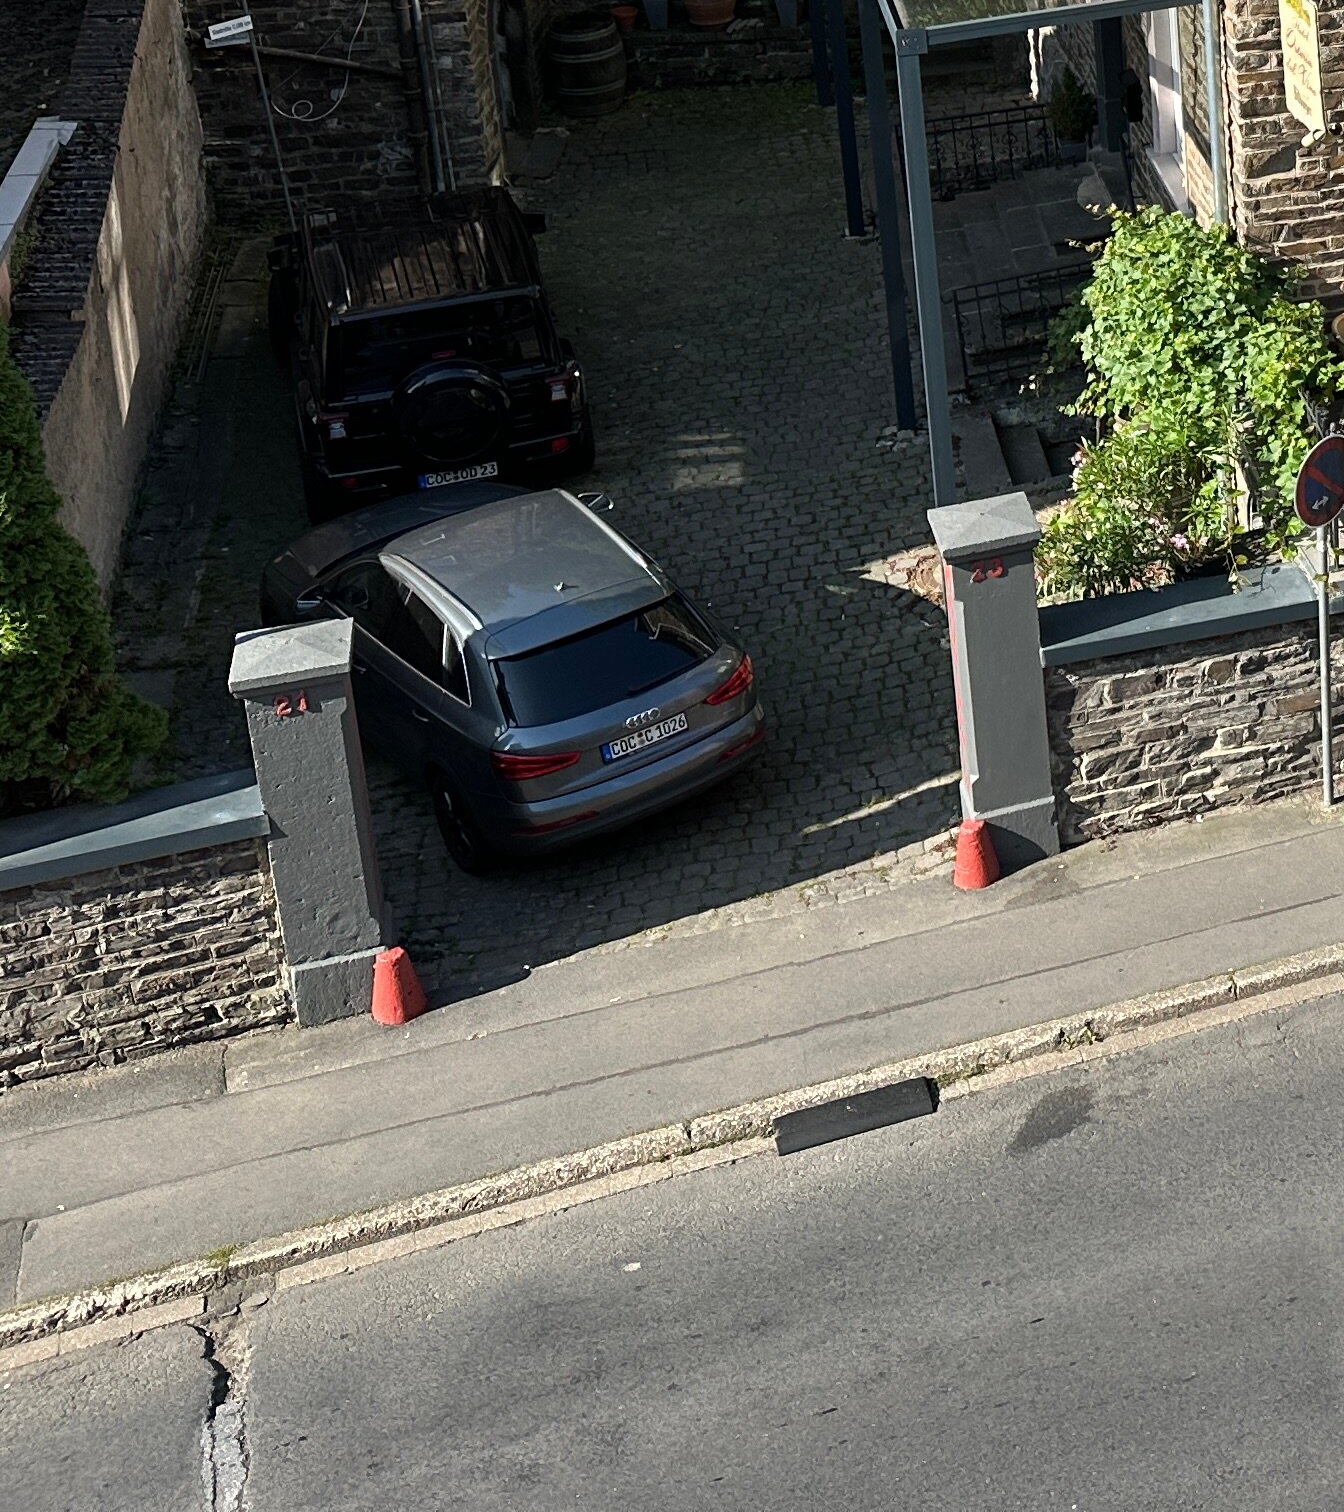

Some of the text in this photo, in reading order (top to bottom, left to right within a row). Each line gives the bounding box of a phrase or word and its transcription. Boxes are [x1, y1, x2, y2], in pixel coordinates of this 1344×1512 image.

[426, 472, 452, 486] COC
[481, 463, 497, 476] 23
[273, 689, 308, 717] 21
[611, 714, 686, 756] COC C 1026
